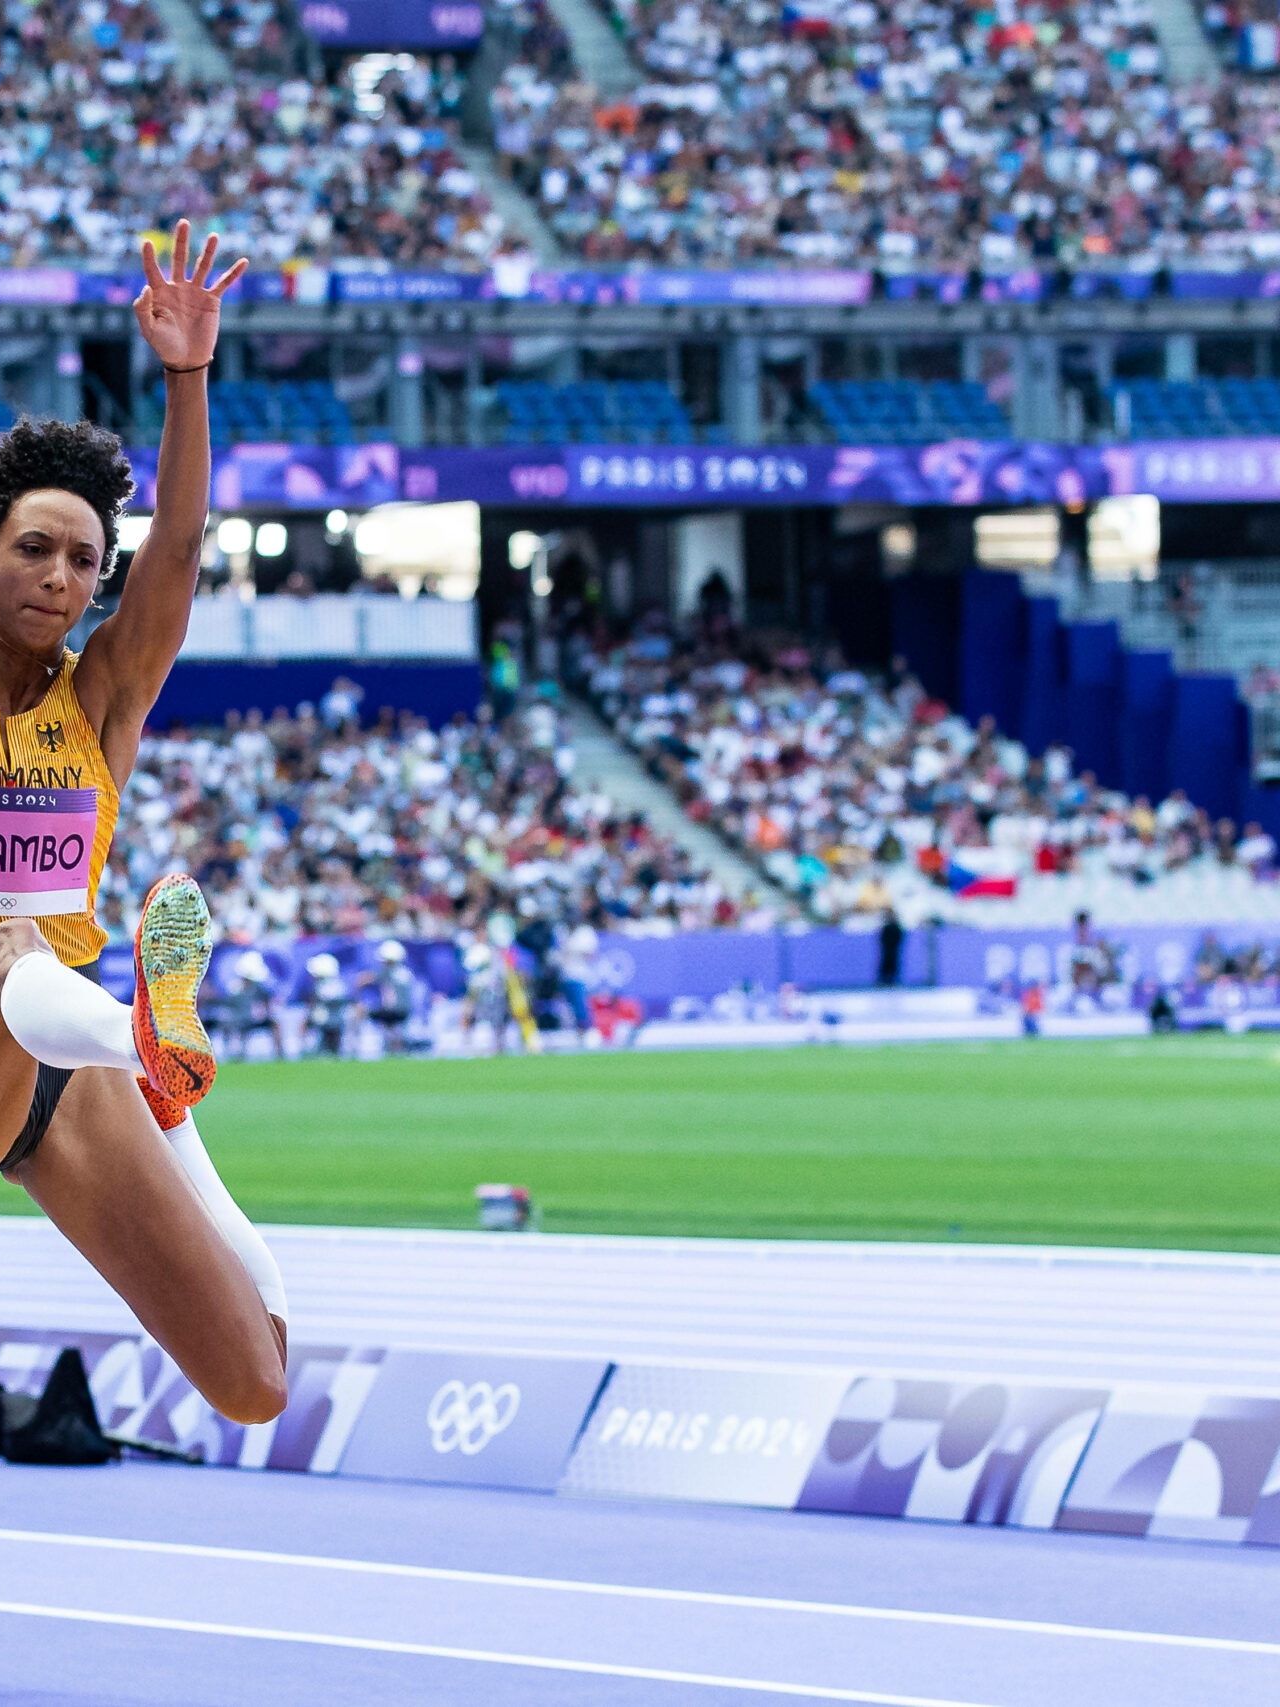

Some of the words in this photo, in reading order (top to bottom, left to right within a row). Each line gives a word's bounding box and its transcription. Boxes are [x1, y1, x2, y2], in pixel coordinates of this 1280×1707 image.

[579, 455, 696, 493] PARIS
[703, 456, 808, 493] 2024
[16, 794, 57, 807] 2024
[598, 1406, 710, 1452] PARIS
[710, 1413, 812, 1458] 2024
